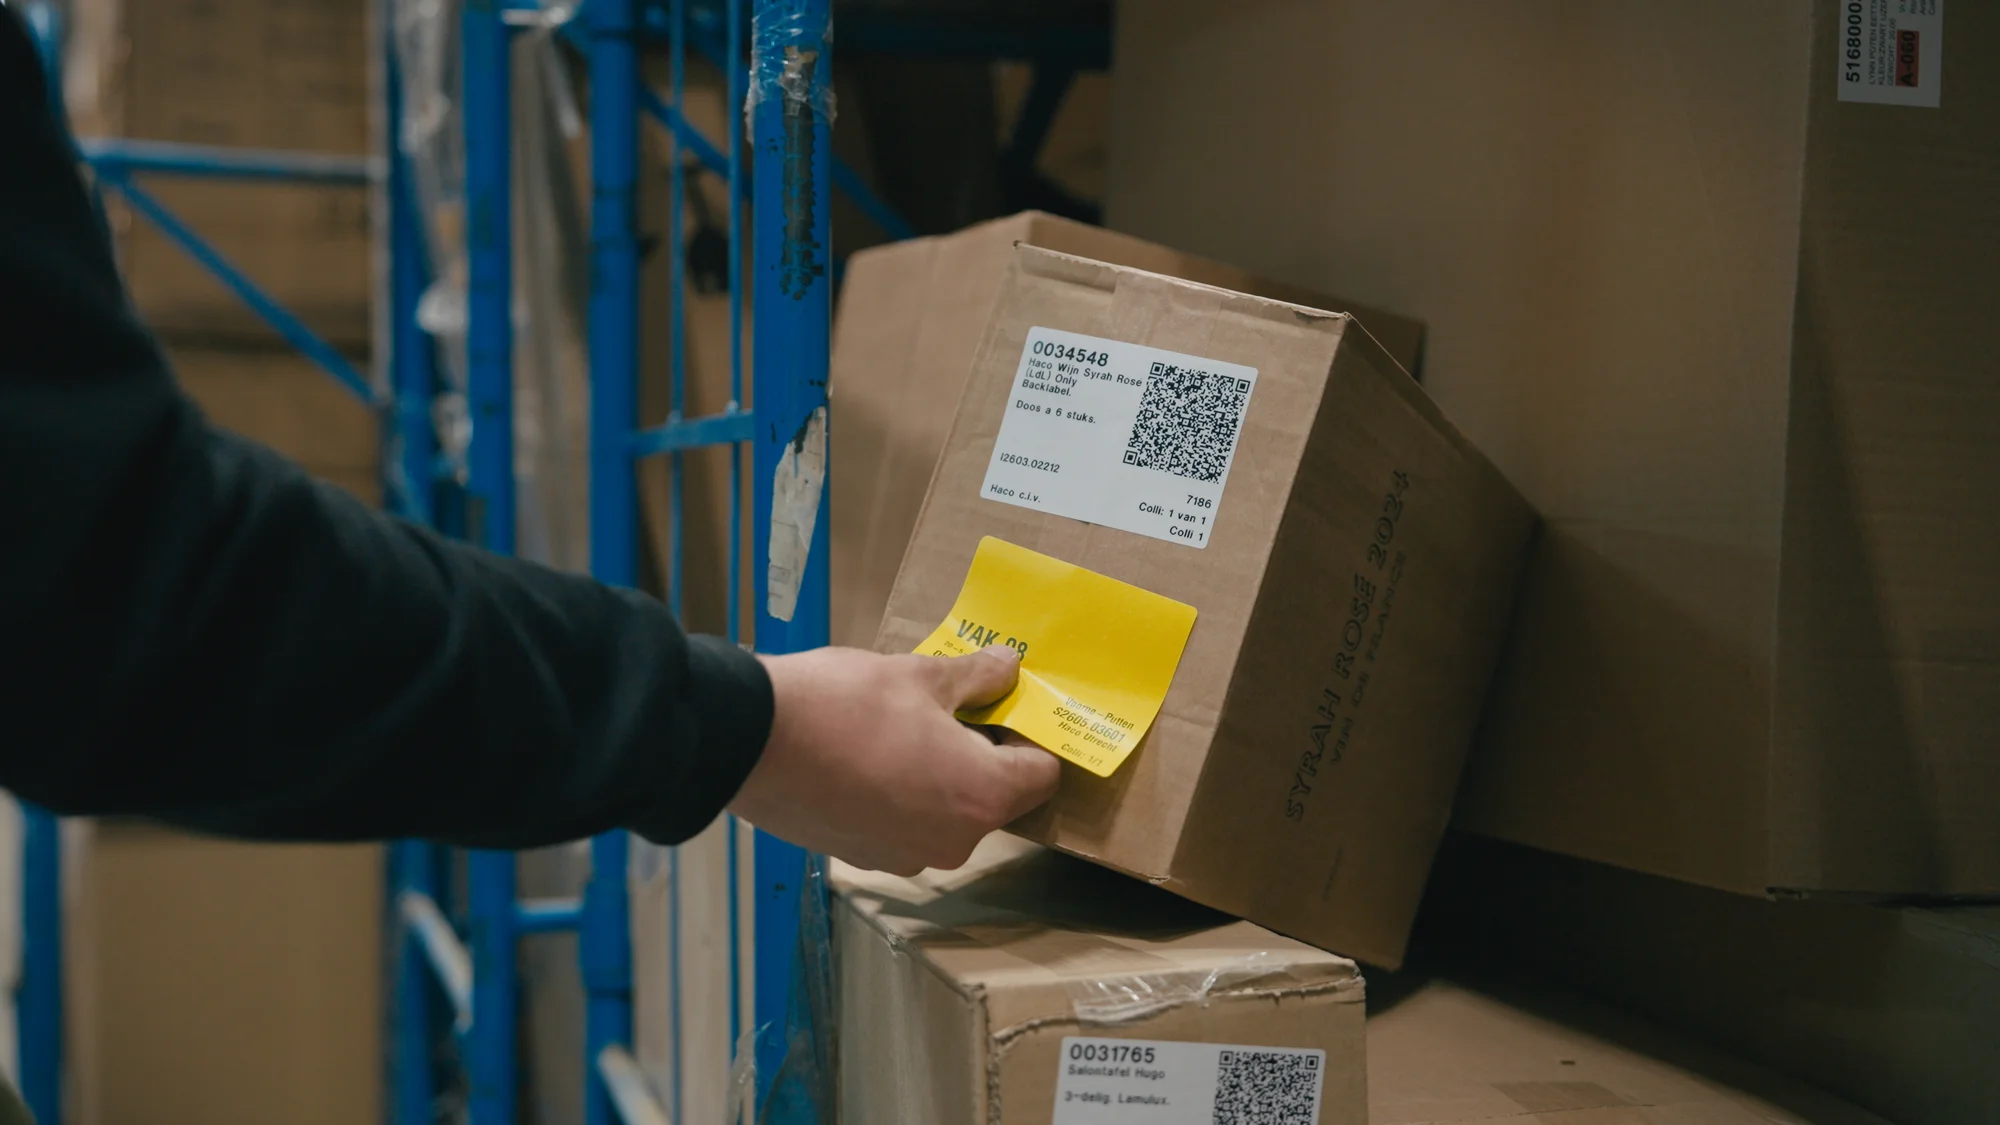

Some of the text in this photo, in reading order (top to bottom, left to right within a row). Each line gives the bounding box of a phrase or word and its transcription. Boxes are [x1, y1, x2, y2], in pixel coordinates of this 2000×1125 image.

[1846, 0, 1862, 82] 5168000
[1869, 28, 1877, 59] POTEN
[1900, 31, 1915, 86] A-060
[1033, 340, 1109, 367] 0034548
[1025, 367, 1078, 387] (LdL) Only
[1028, 357, 1053, 370] Haco
[1058, 363, 1080, 375] Wijn
[1083, 367, 1113, 383] Syrah
[1022, 379, 1072, 397] Backlabel.
[1016, 400, 1096, 424] Doos a 6 stuks.
[990, 484, 1041, 503] Haco c.i.v.
[1187, 495, 1212, 509] 7186
[1138, 502, 1206, 525] Colli: 1 van 1
[1169, 525, 1204, 541] Colli 1
[1364, 548, 1406, 664] FRANCE
[956, 619, 1001, 648] VAK
[1283, 686, 1341, 824] SYRAH
[1366, 469, 1411, 569] 2024
[1052, 706, 1126, 743] S2605.03601
[1058, 721, 1119, 752] Haco Utrecht
[1061, 743, 1104, 767] Colli: 1/1
[1069, 1043, 1156, 1064] 0031765
[1067, 1064, 1166, 1081] Salontafel Hugo
